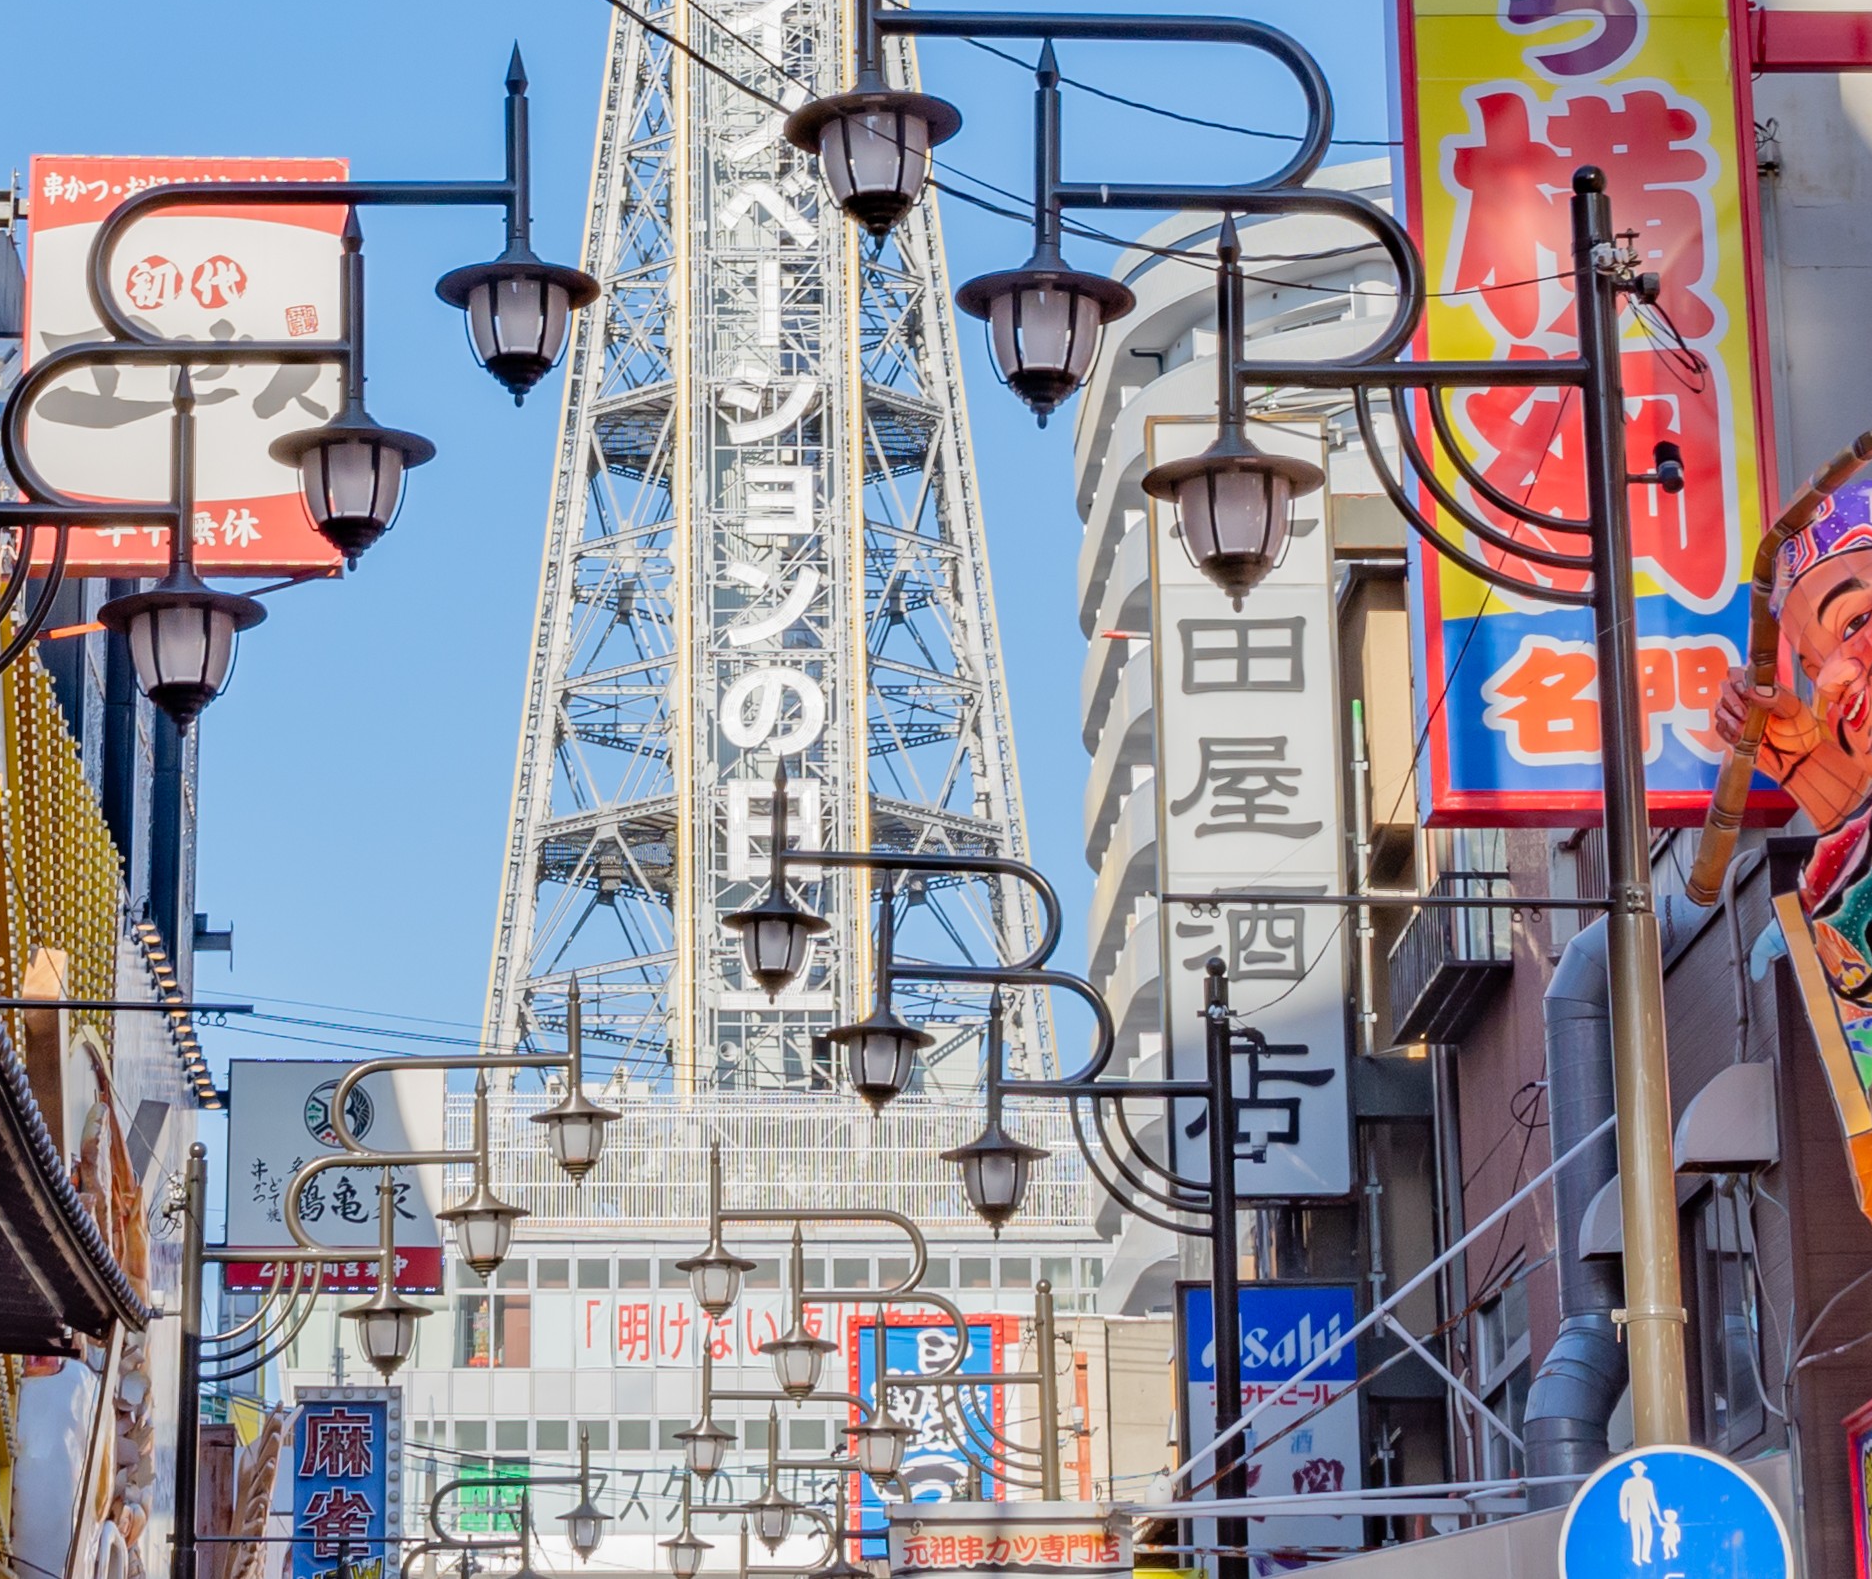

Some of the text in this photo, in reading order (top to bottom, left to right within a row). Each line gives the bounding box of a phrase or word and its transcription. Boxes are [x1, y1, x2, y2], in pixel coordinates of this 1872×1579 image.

[1453, 90, 1724, 602] 横綱
[1494, 646, 1729, 753] 名門
[1168, 518, 1336, 1146] 田屋酒店
[298, 1407, 376, 1557] 麻雀
[903, 1533, 1121, 1567] 元祖串カツ専門店
